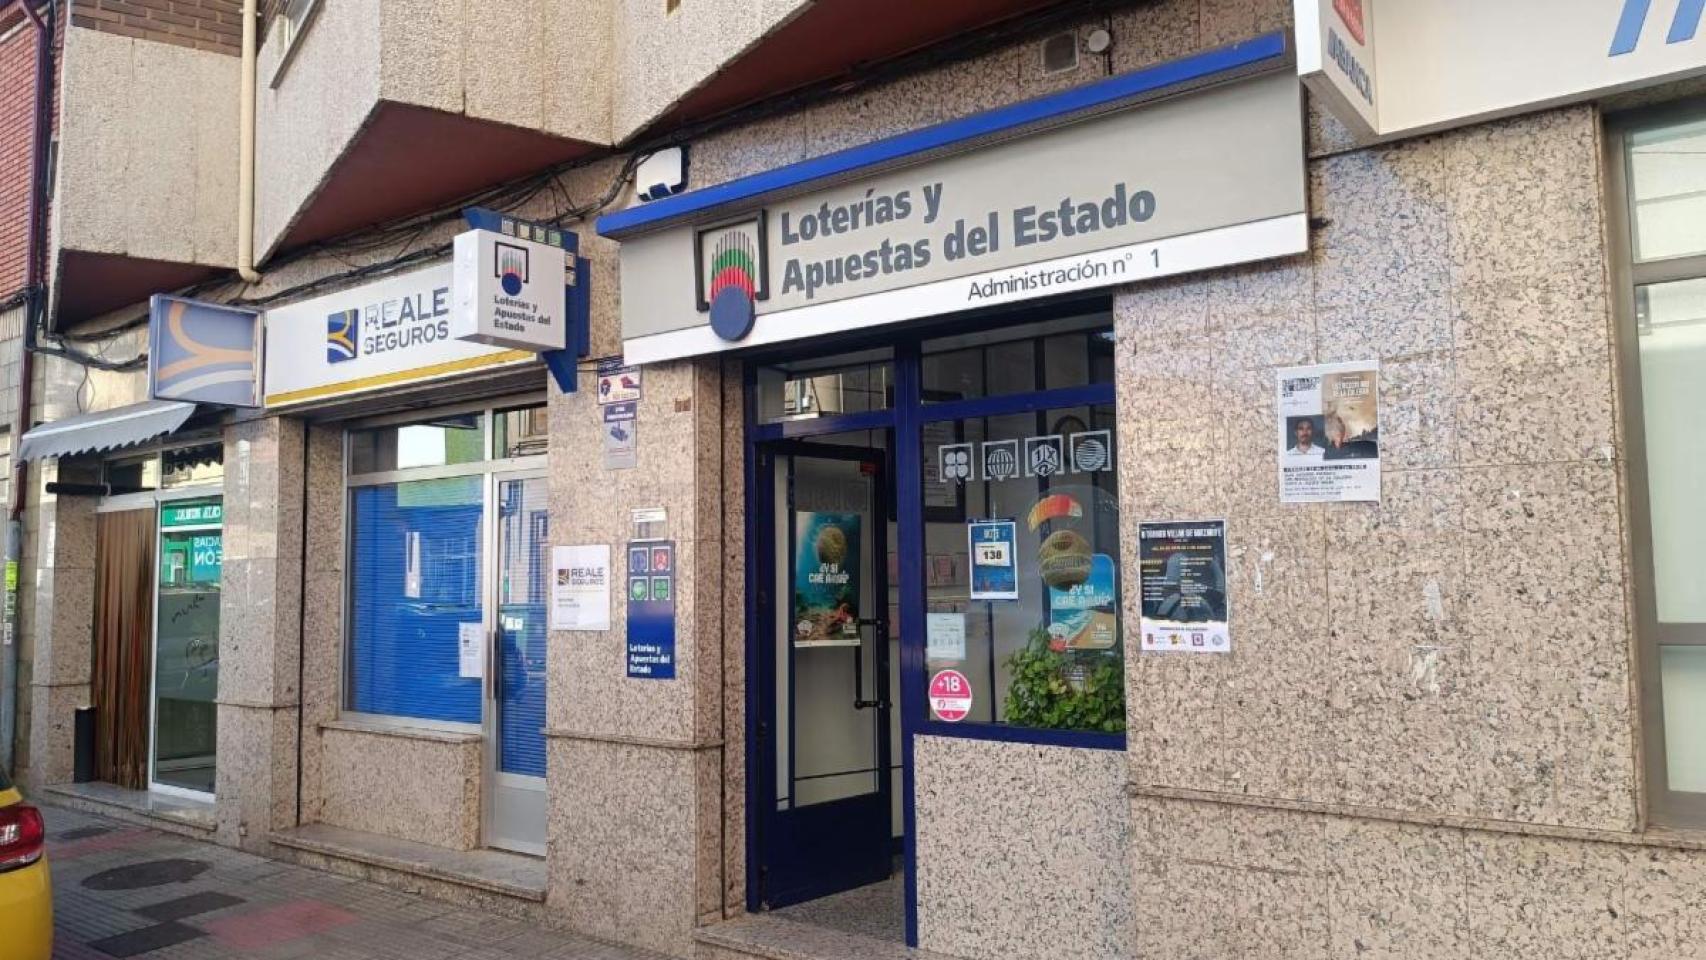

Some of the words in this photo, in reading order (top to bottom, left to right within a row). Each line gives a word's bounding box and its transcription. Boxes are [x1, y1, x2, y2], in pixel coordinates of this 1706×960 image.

[781, 188, 912, 246] Loterías
[922, 182, 944, 225] y
[781, 237, 932, 300] Apuestas
[943, 218, 999, 262] del
[1013, 182, 1157, 247] Estado
[967, 253, 1108, 301] Administración
[1150, 248, 1160, 269] 1
[364, 286, 450, 331] REALE
[493, 306, 536, 323] Apuestas
[537, 314, 552, 325] del
[493, 318, 526, 333] Estado
[363, 319, 450, 356] SEGUROS
[571, 567, 604, 577] REALE
[937, 676, 961, 693] +18
